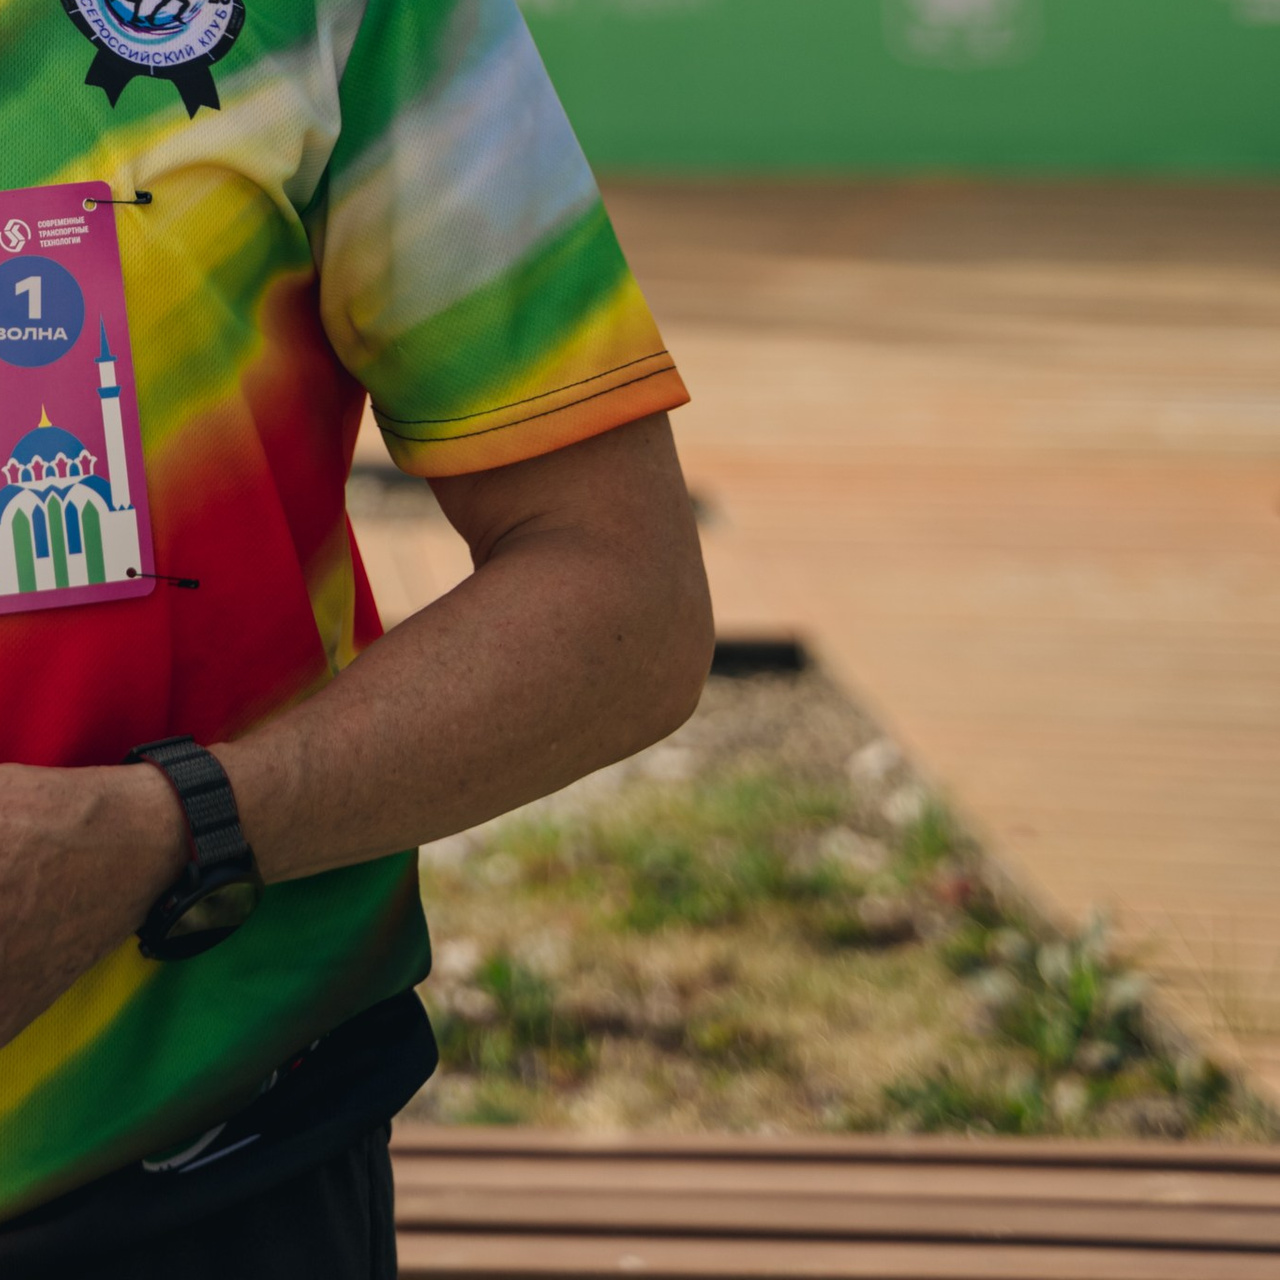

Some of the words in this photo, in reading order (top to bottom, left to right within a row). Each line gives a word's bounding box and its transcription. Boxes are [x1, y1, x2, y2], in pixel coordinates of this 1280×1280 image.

[198, 9, 227, 47] КЛУБ
[37, 216, 85, 228] СОВРЕМЕННЫЕ
[38, 225, 89, 237] ТРАНСПОРТНЫЕ
[39, 236, 81, 247] ТЕХНОЛОГИИ
[15, 275, 42, 319] 1
